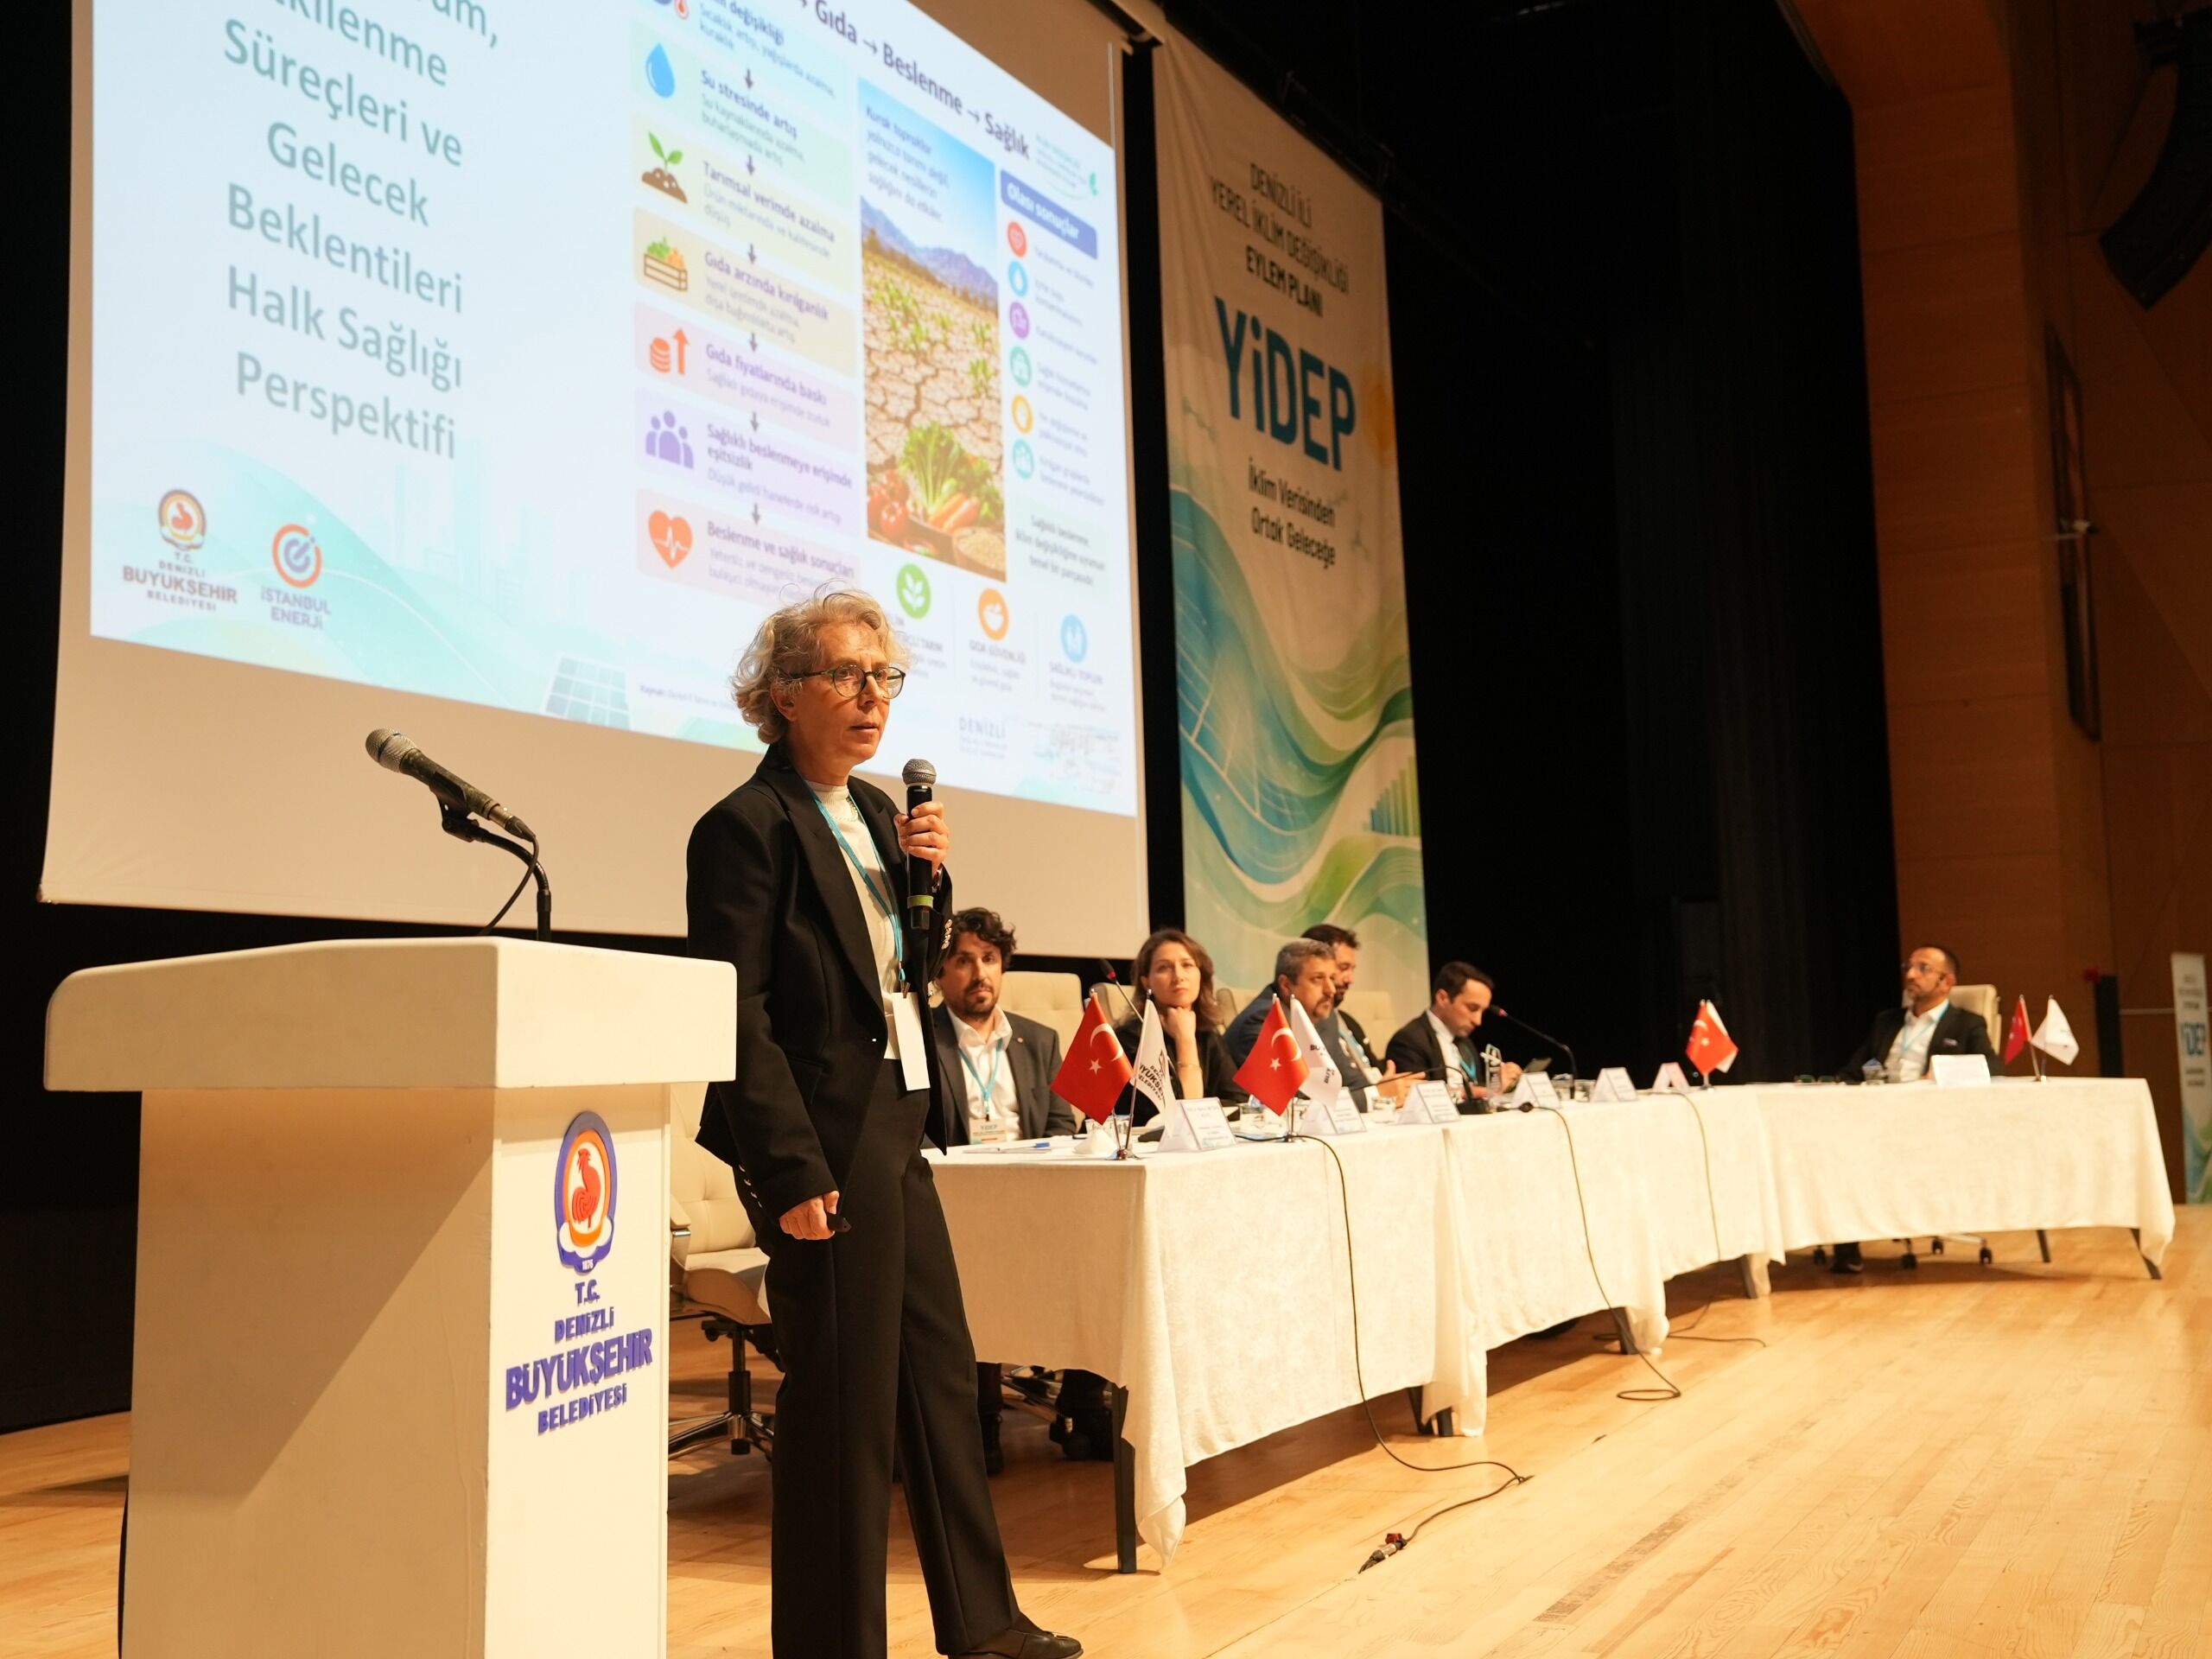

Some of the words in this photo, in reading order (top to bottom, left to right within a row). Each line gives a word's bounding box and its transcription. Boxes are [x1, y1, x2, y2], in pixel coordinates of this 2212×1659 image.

[224, 18, 408, 143] Süreçleri
[421, 121, 463, 167] ve
[701, 69, 715, 90] Su
[718, 80, 770, 123] stresinde
[815, 0, 858, 46] Gıda
[882, 41, 963, 115] Beslenme
[984, 112, 1031, 160] Sağlık
[267, 121, 429, 227] Gelecek
[703, 160, 751, 199] Tarımsal
[754, 191, 796, 220] verimde
[1211, 175, 1250, 228] YEREL
[227, 182, 462, 314] Beklentileri
[704, 251, 732, 275] Gıda
[1245, 244, 1287, 295] EYLEM
[1287, 271, 1324, 318] PLANI
[227, 264, 326, 340] Halk
[338, 306, 462, 394] Sağlığı
[705, 343, 732, 366] Gıda
[236, 351, 455, 460] Perspektifi
[1278, 475, 1336, 529] Verisinden
[707, 519, 761, 550] Beslenme
[1250, 505, 1284, 543] Ortak
[1286, 520, 1337, 570] Geleceğe
[575, 1279, 601, 1306] T.C.
[554, 1306, 614, 1344] DENİZLİ
[505, 1327, 653, 1413] BÜYÜKŞEHİR
[537, 1382, 628, 1436] BELEDİYESİ
